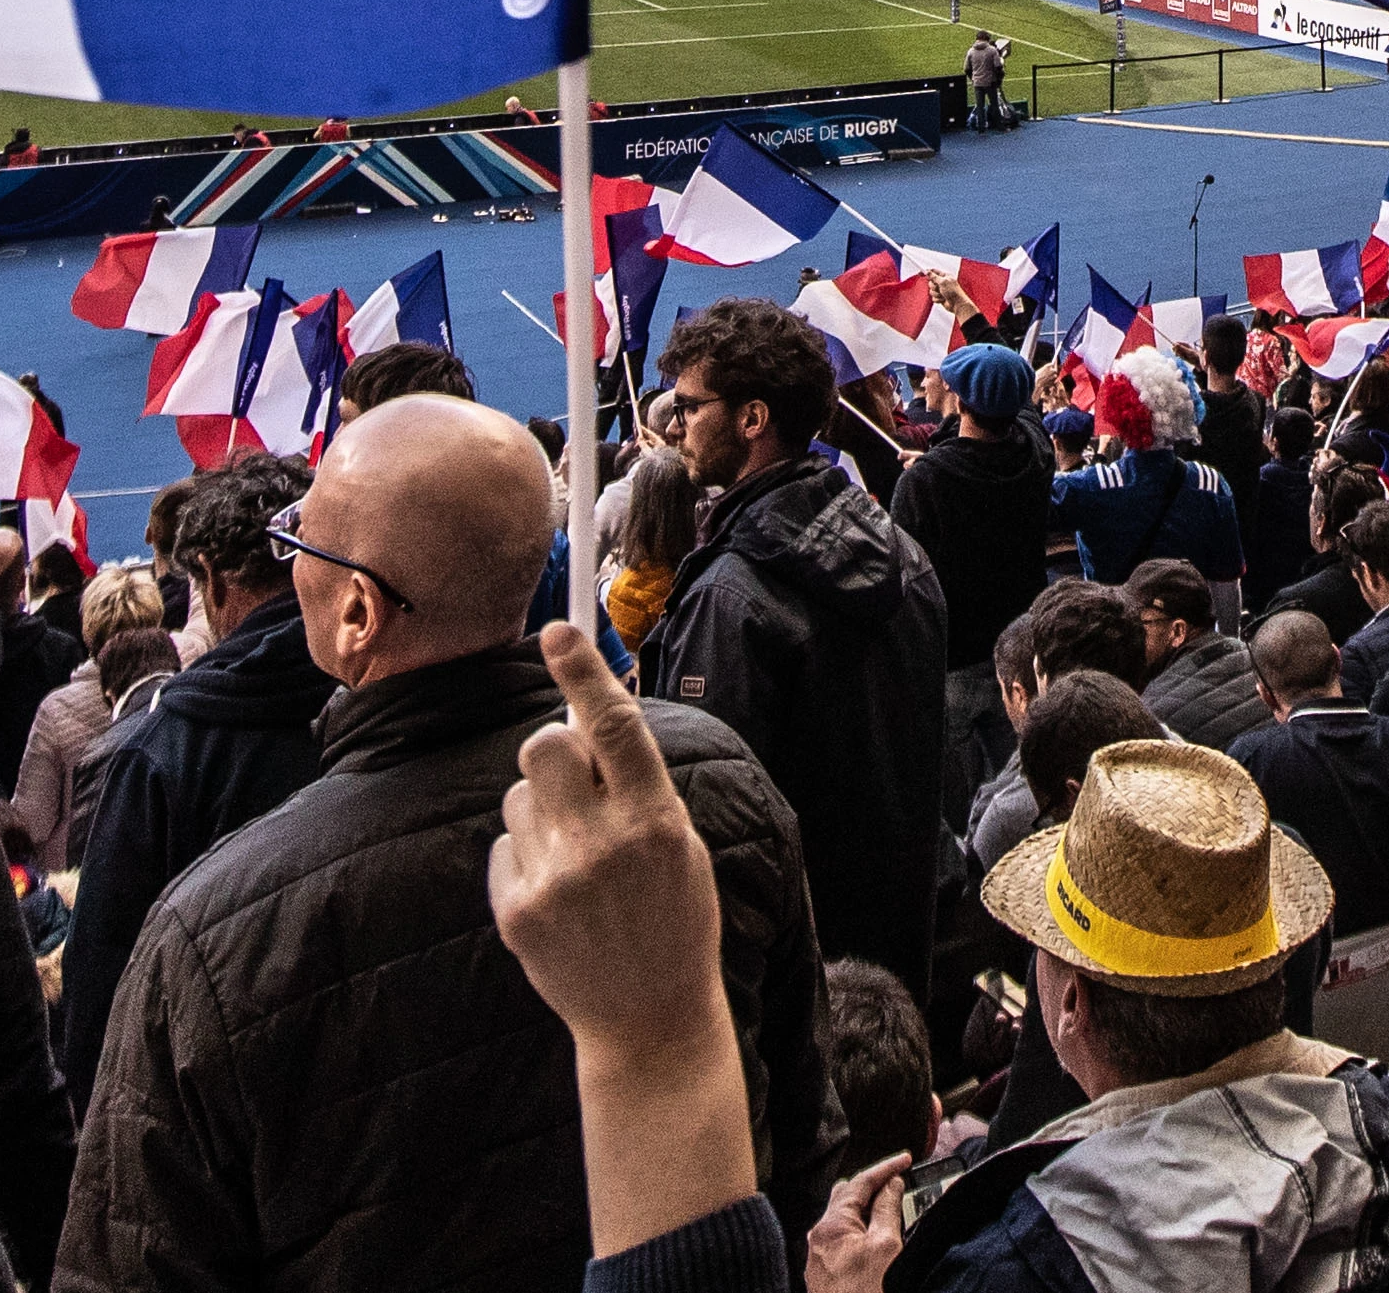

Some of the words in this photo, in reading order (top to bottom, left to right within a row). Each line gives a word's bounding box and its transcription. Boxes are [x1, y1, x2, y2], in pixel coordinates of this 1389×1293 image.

[1231, 1, 1258, 16] ALTRAD
[1297, 12, 1308, 35] le
[1310, 20, 1334, 46] coq
[1336, 25, 1381, 51] sportif
[626, 136, 711, 160] FÉDÉRATIO
[750, 127, 814, 150] ANÇAISE
[820, 125, 839, 141] DE
[844, 118, 898, 139] RUGBY
[1057, 879, 1091, 933] RICARD
